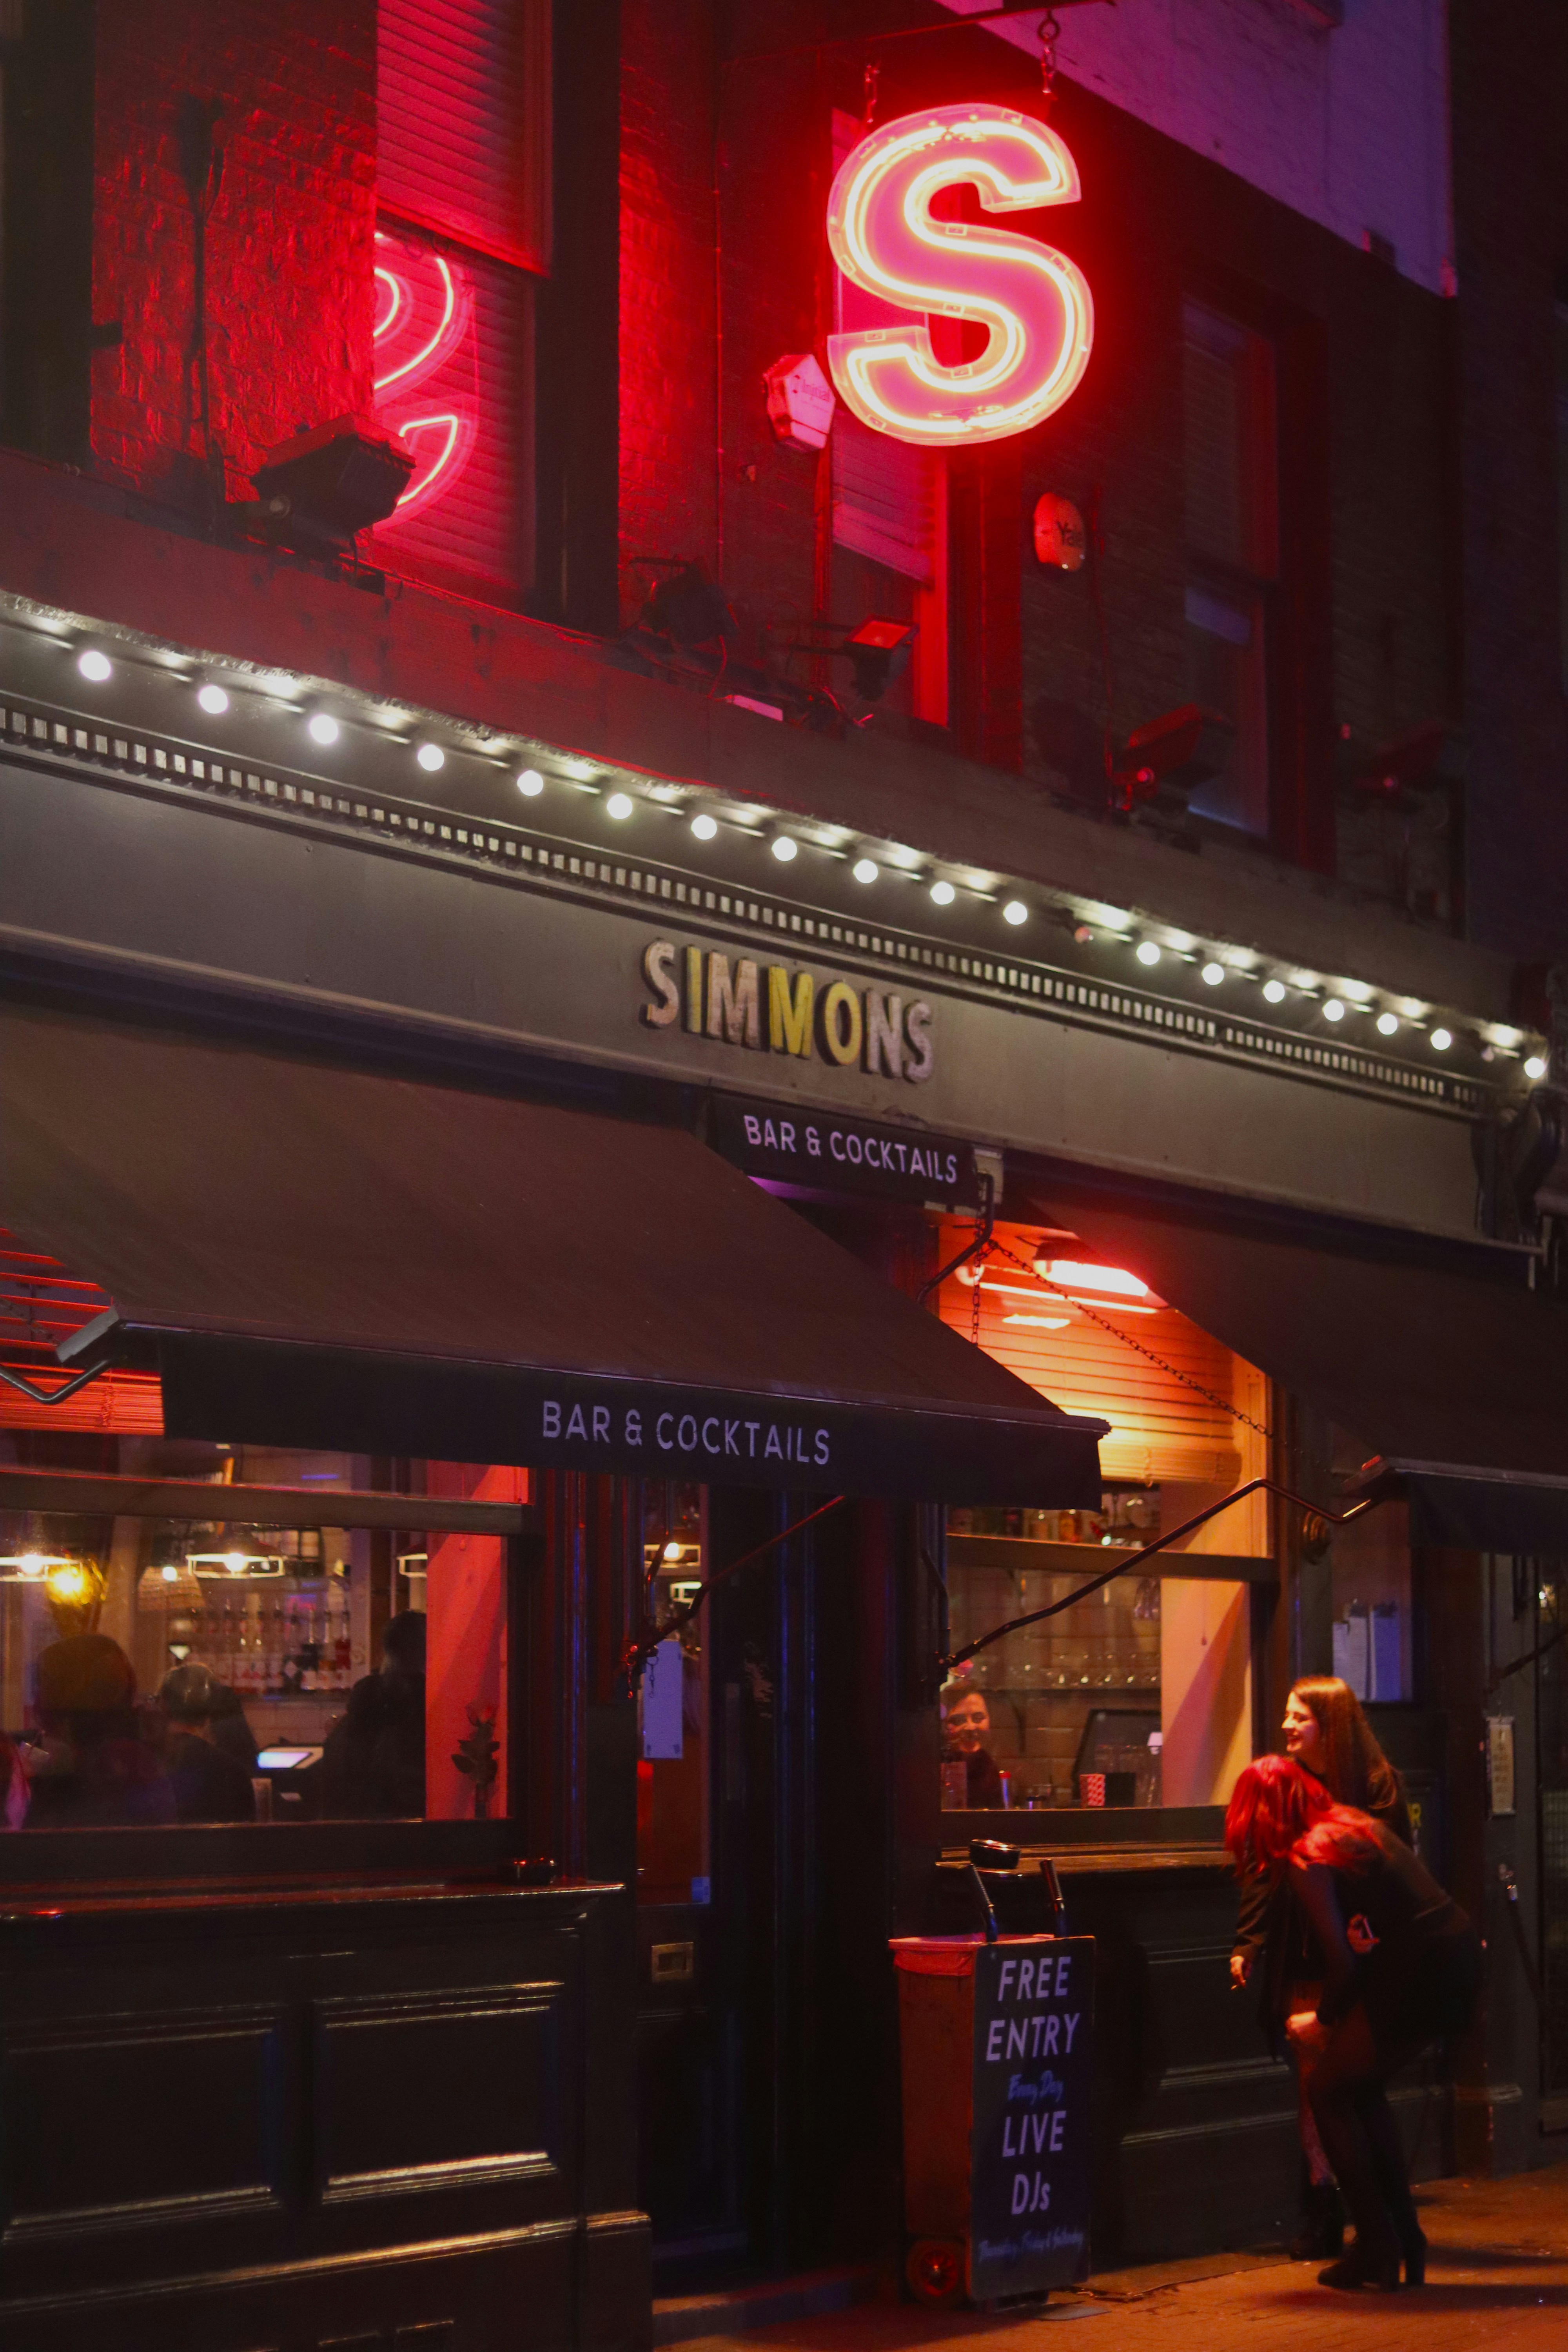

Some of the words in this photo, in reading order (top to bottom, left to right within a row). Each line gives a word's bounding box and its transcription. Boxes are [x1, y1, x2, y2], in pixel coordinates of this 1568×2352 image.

[826, 103, 1094, 446] S
[644, 940, 933, 1083] SIMMONS
[743, 1114, 796, 1152] BAR
[805, 1126, 821, 1156] &
[830, 1131, 957, 1183] COCKTAILS
[543, 1400, 610, 1443] BAR
[625, 1409, 642, 1446] &
[656, 1412, 830, 1465] COCKTAILS
[998, 1956, 1071, 2001] FREE
[985, 2013, 1080, 2061] ENTRY
[1002, 2110, 1066, 2157] LIVE
[1011, 2171, 1051, 2215] DJs
